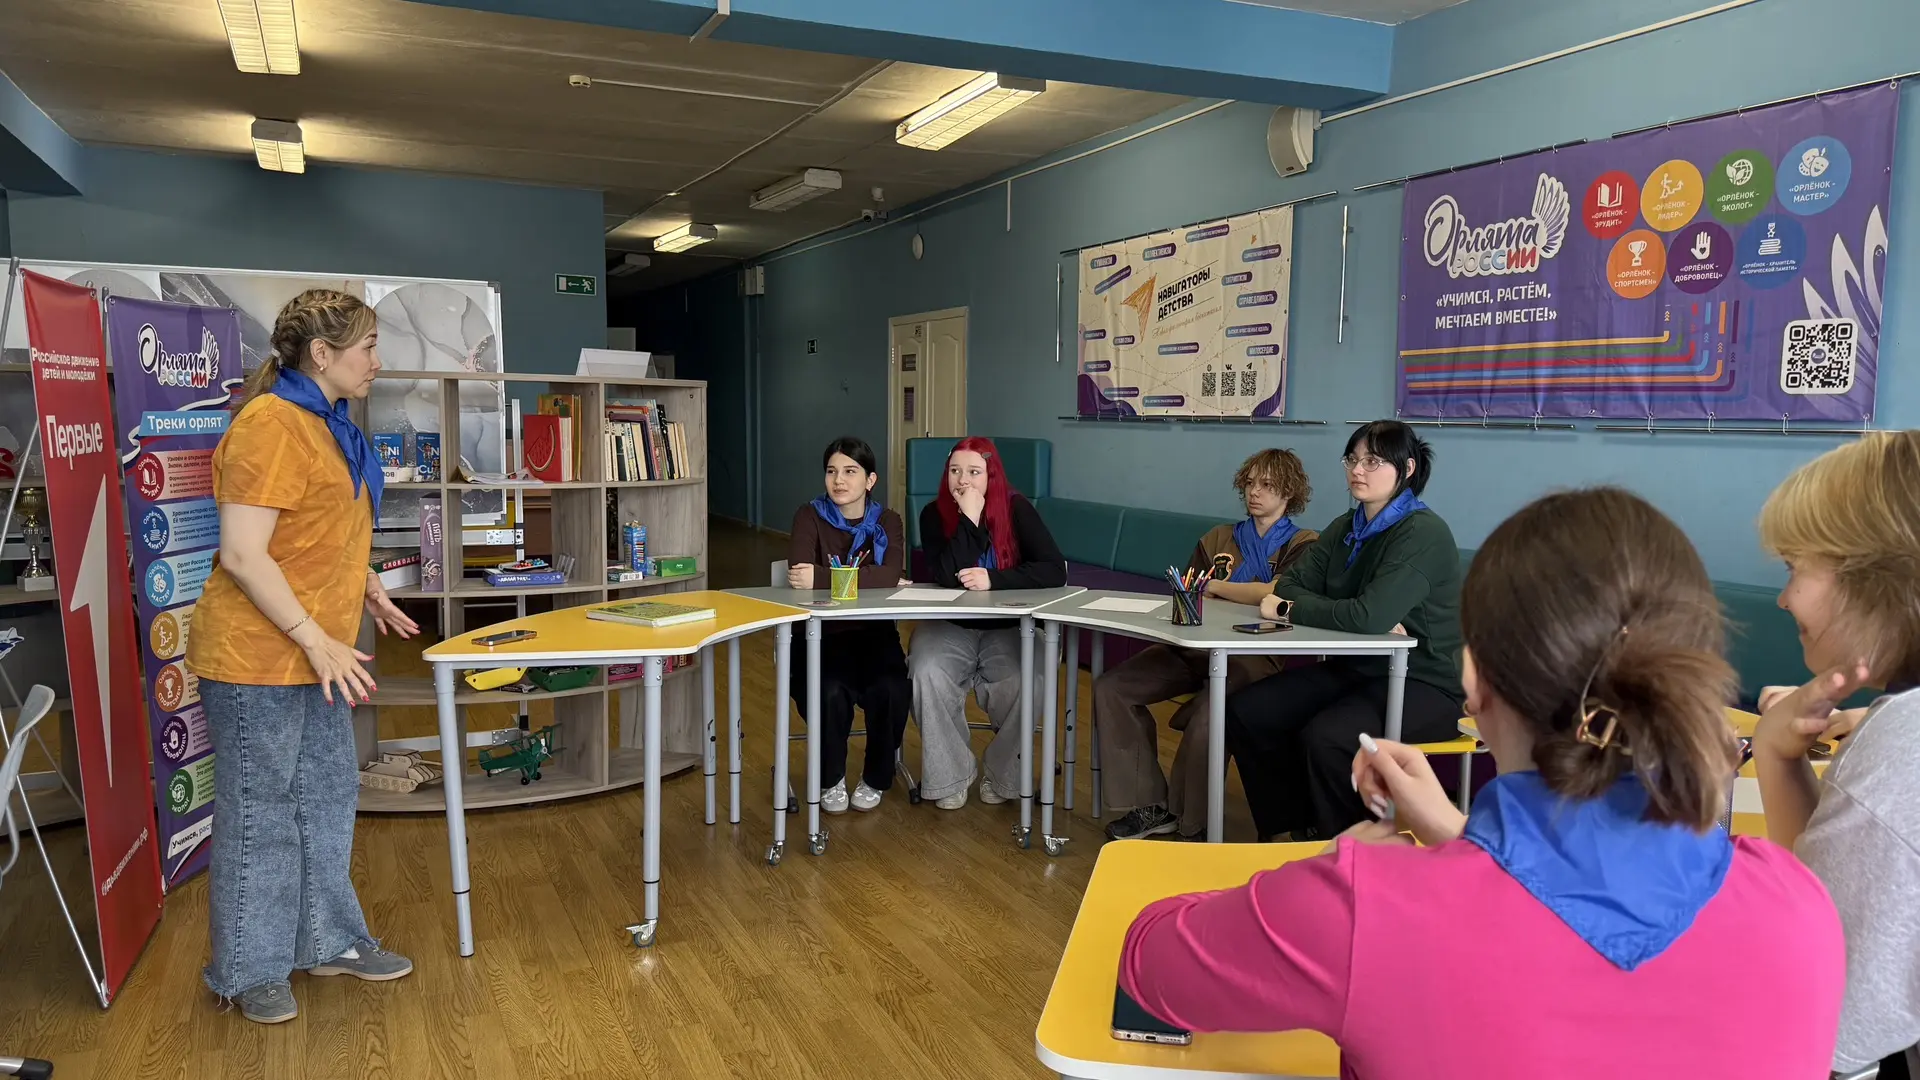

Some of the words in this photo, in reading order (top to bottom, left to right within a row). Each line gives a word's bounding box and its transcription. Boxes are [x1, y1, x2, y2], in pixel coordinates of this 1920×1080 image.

[1789, 181, 1830, 192] «ОРЛЁНОК
[1716, 191, 1755, 202] «ОРЛЁНОК
[1793, 192, 1829, 203] МАСТЕР»
[1652, 201, 1686, 211] «ОРЛЁНОК
[1721, 202, 1753, 212] ЭКОЛОГ»
[1592, 210, 1623, 219] «ОРЛЁНОК
[1658, 212, 1683, 220] ЛИДЕР»
[1595, 220, 1622, 228] ЭРУДИТ»
[1427, 198, 1539, 267] Орлята
[1452, 246, 1537, 274] РОССИИ
[1679, 263, 1714, 272] «ОРЛЁНОК
[1617, 269, 1651, 278] «ОРЛЁНОК
[1674, 272, 1723, 283] ДОБРОВОЛЕЦ»
[1157, 267, 1211, 303] НАВИГАТОРЫ
[1614, 279, 1656, 287] СПОРТСМЕН»
[1436, 289, 1494, 307] «УЧИМСЯ,
[1497, 281, 1552, 302] РАСТЁМ,
[1157, 292, 1194, 320] ДЕТСТВА
[1435, 312, 1492, 329] МЕЧТАЕМ
[1495, 307, 1558, 325] ВМЕСТЕ!»
[31, 347, 70, 365] Российское
[71, 355, 100, 368] движение
[138, 323, 207, 379] Орлята
[42, 366, 61, 380] детей
[61, 370, 65, 379] и
[66, 367, 96, 382] молодёжи
[160, 370, 208, 387] РОССИИ
[147, 415, 186, 433] Треки
[189, 416, 222, 431] орлят
[45, 415, 103, 470] Первые
[388, 446, 400, 456] Ni
[419, 464, 434, 474] Cu
[140, 484, 160, 497] ЭРУДИТ
[143, 529, 168, 550] ХРАНИТЕЛЬ
[432, 522, 442, 543] ПЯТЬ
[151, 589, 171, 603] МАСТЕР
[157, 643, 174, 656] ЛИДЕР
[158, 685, 182, 707] СПОРТСМЕН
[162, 733, 187, 760] ДОБРОВОЛЕЦ
[171, 796, 190, 813] ЭКОЛОГ
[171, 830, 199, 849] Учимся,
